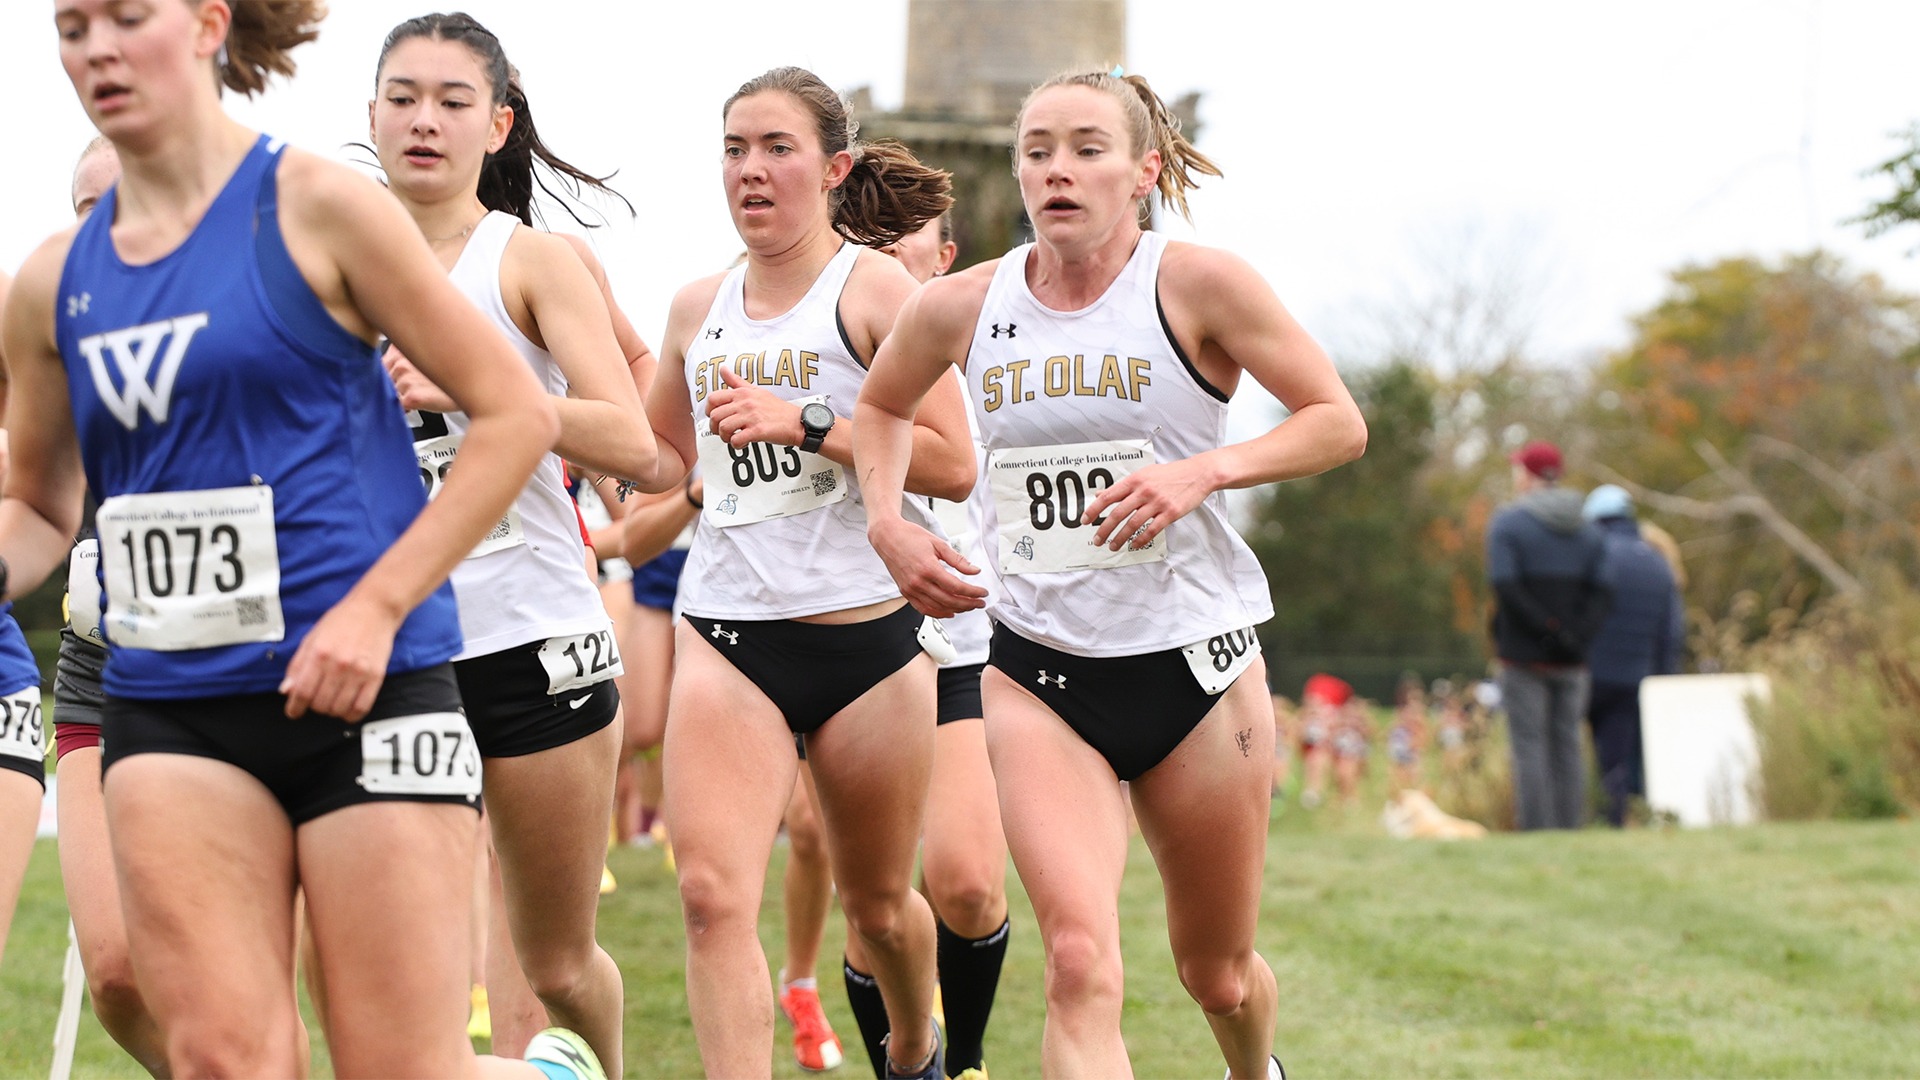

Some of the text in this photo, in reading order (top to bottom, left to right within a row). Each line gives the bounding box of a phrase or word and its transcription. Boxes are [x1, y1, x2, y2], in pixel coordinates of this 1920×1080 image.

[79, 311, 209, 431] W
[734, 349, 820, 390] OLAF
[983, 354, 1152, 413] ST. OLAF
[727, 441, 802, 488] 803
[994, 450, 1144, 470] Connecticut College Invitational
[121, 524, 244, 599] 1073
[562, 630, 619, 677] 122
